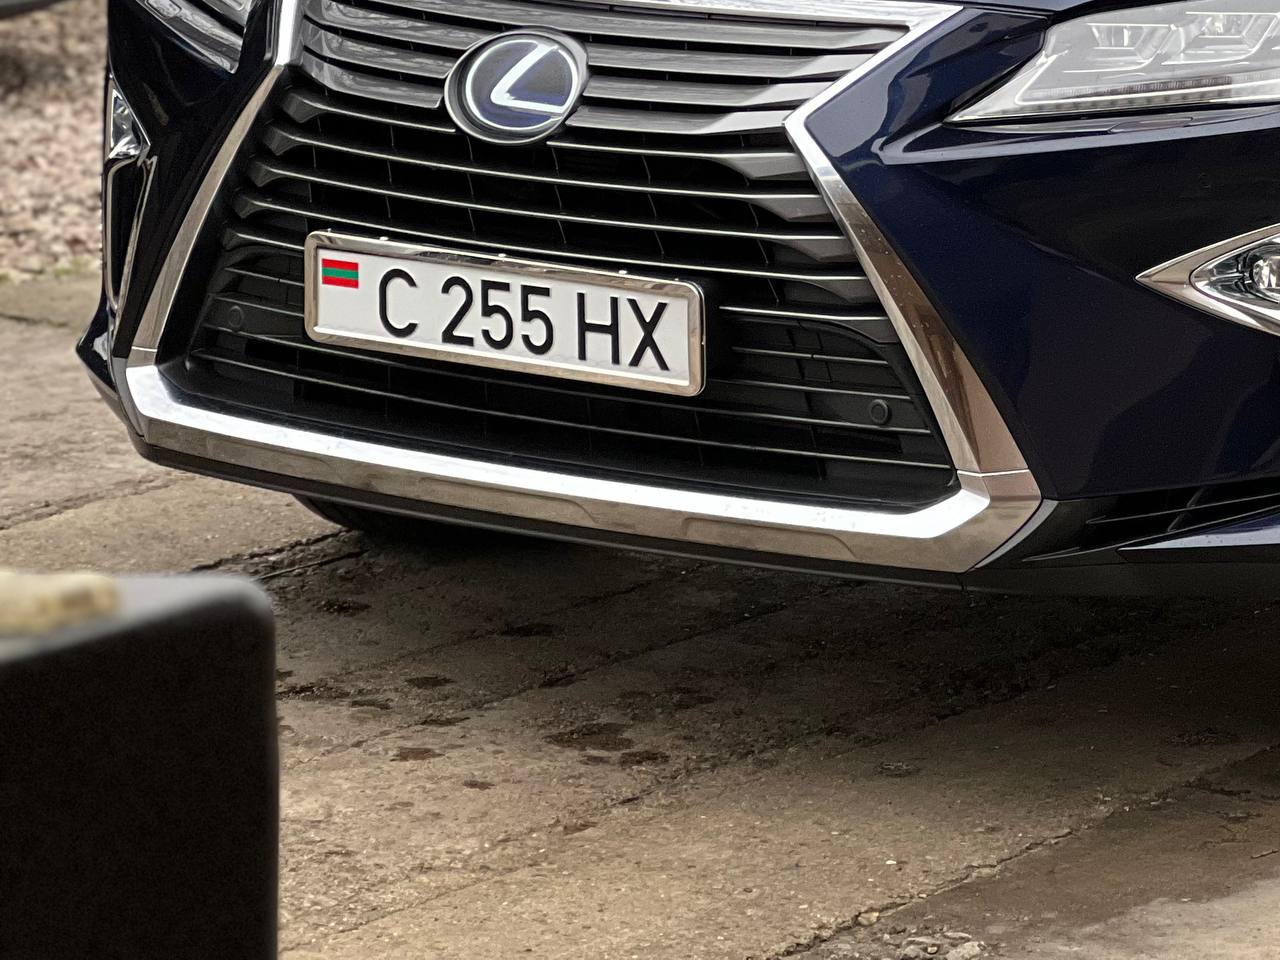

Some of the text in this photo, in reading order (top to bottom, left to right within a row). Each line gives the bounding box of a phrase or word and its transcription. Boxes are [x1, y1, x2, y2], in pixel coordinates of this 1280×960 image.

[378, 268, 671, 372] C 255 HX
